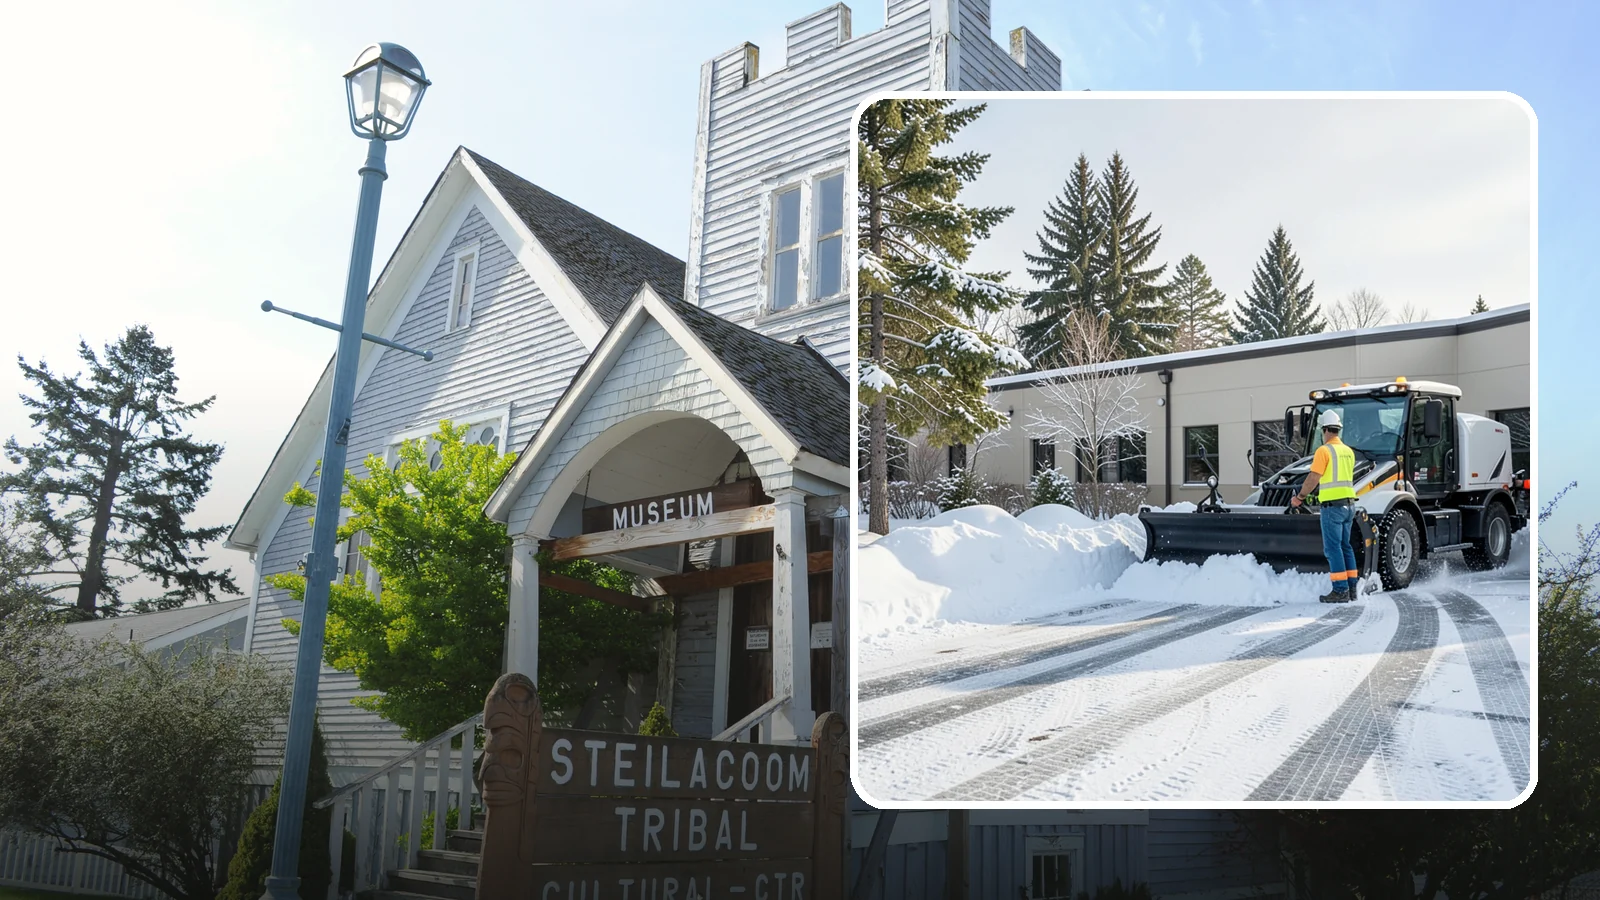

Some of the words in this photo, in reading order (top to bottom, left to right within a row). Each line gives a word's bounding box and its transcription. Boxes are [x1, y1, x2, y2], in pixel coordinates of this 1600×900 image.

[612, 491, 714, 531] MUSEUM
[550, 738, 810, 793] STEILACOOM
[614, 806, 758, 852] TRIBAL
